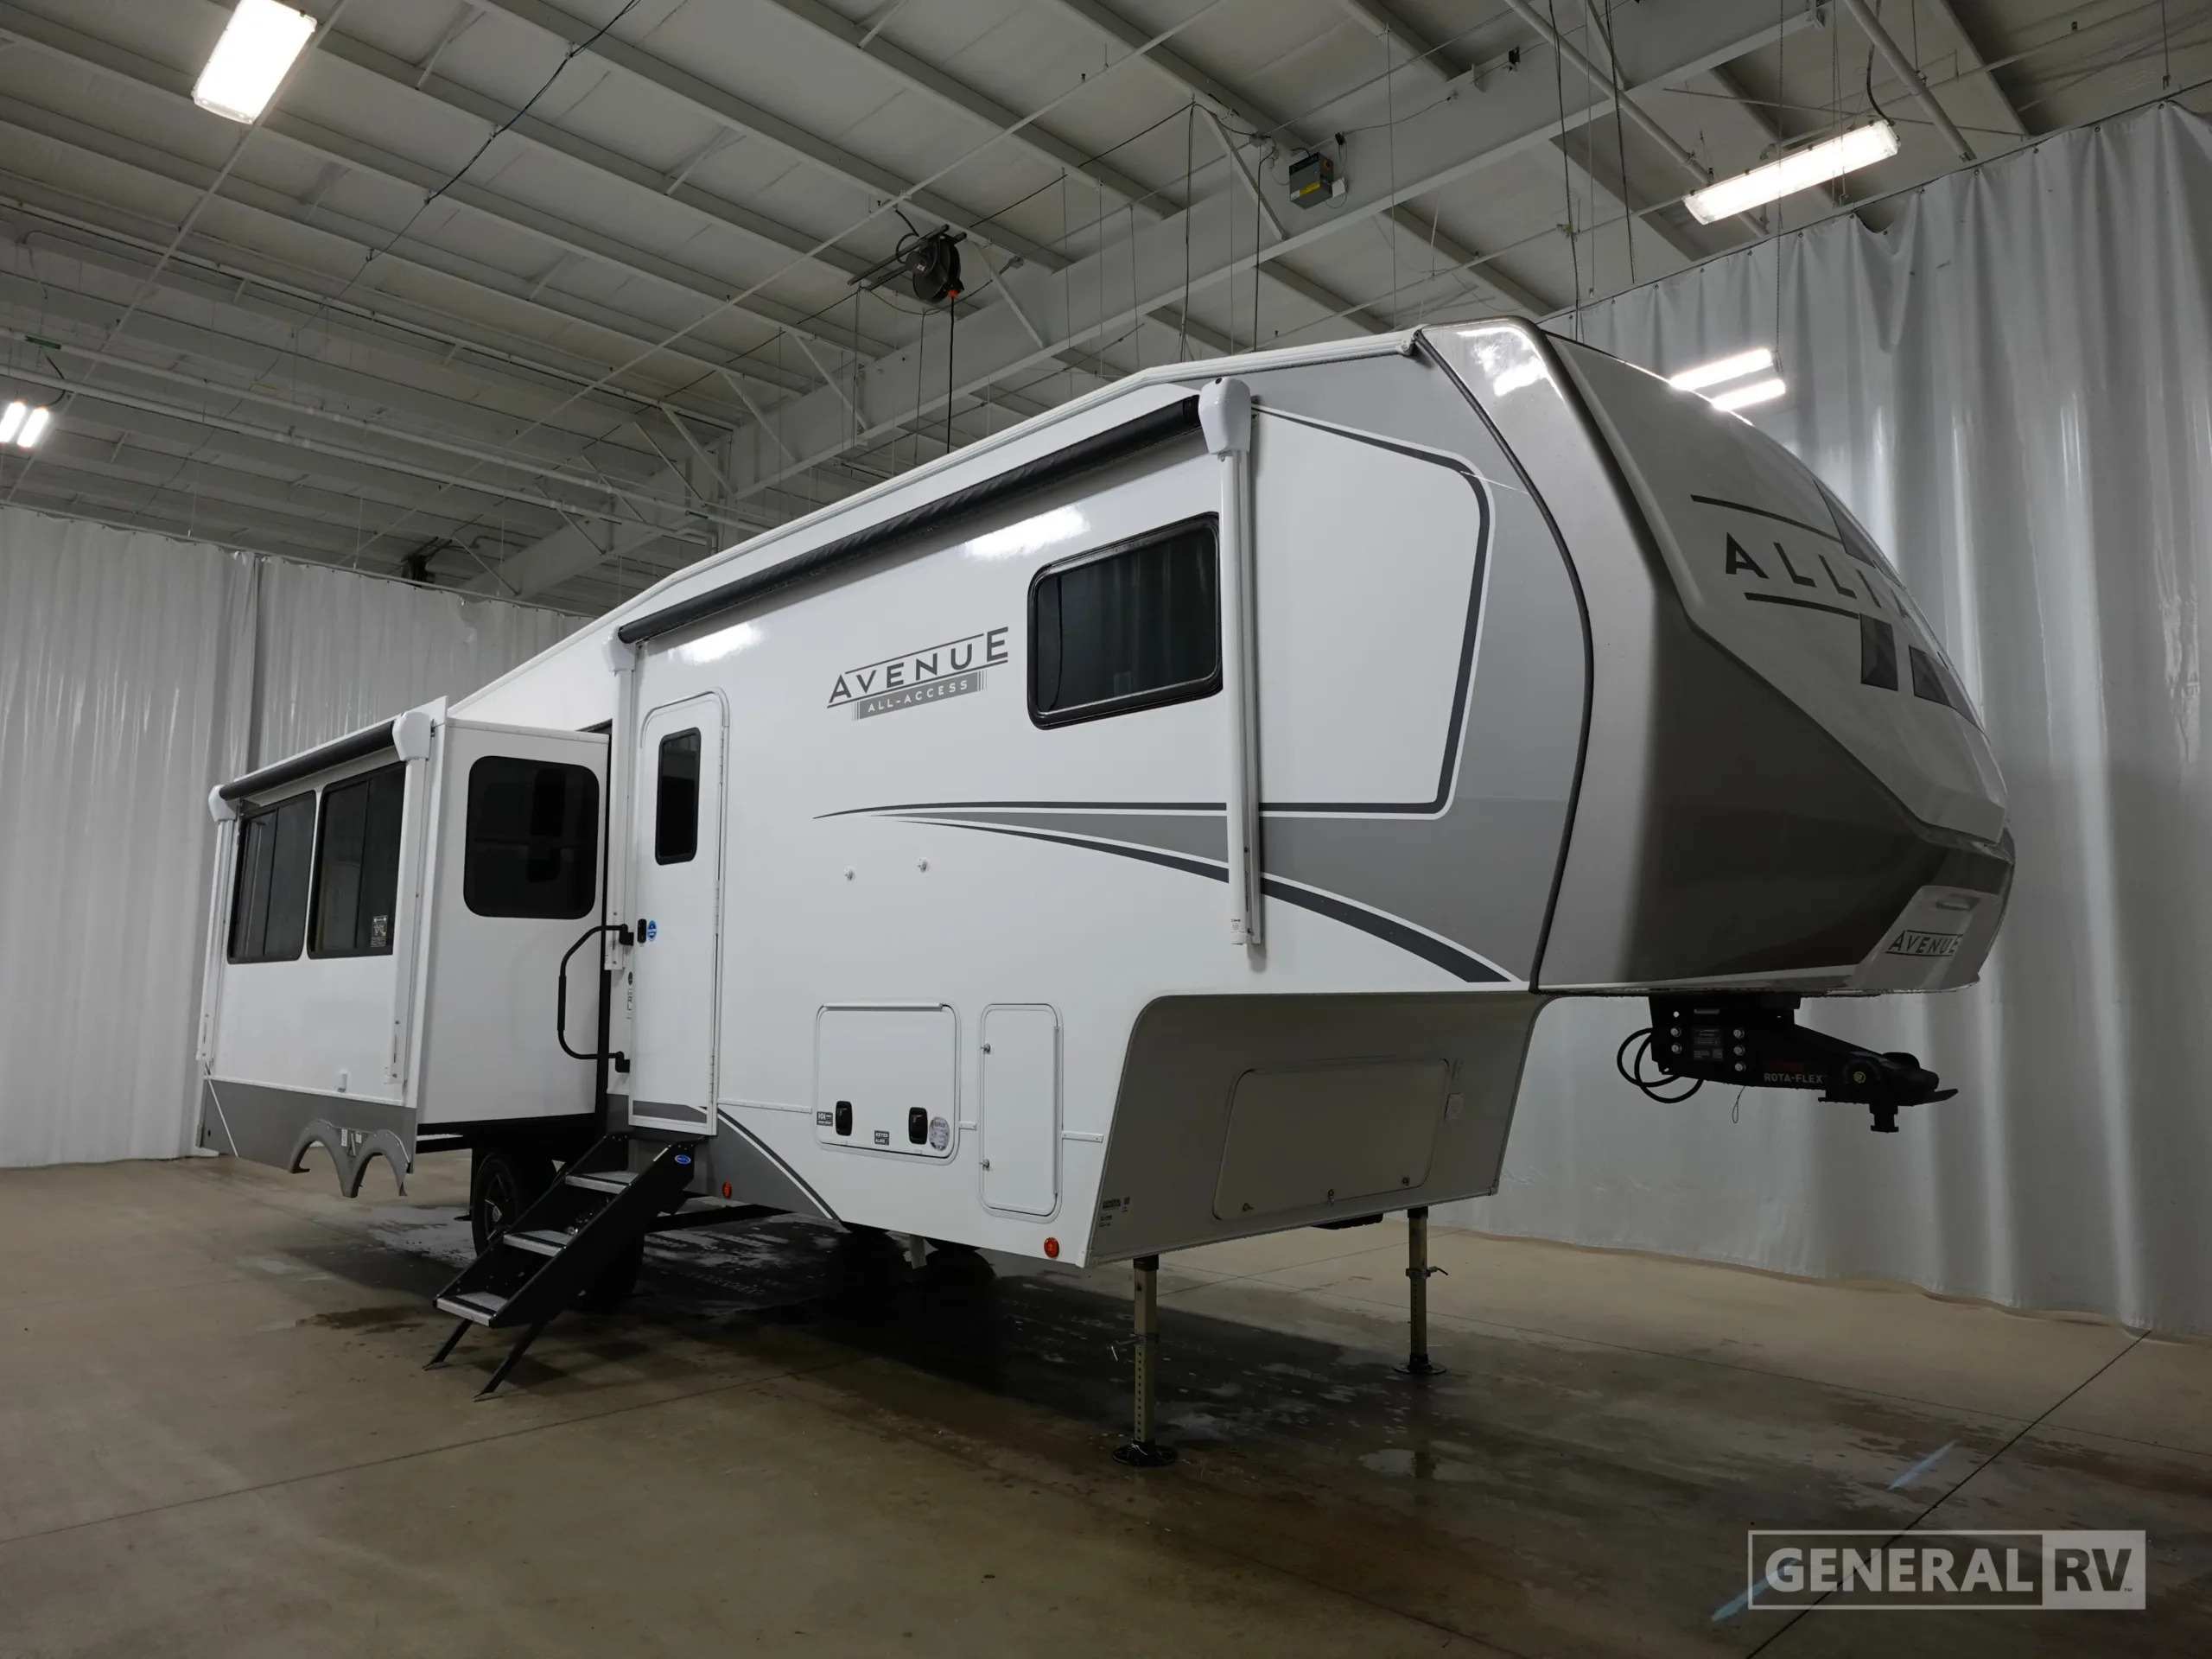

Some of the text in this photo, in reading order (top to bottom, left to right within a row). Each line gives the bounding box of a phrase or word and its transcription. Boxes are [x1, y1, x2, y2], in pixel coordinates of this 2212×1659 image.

[829, 626, 1008, 703] AVENUE
[868, 680, 968, 712] ALL-ACCESS
[1888, 930, 1963, 954] AVENUE
[1764, 1073, 1822, 1084] ROTA-FLEX
